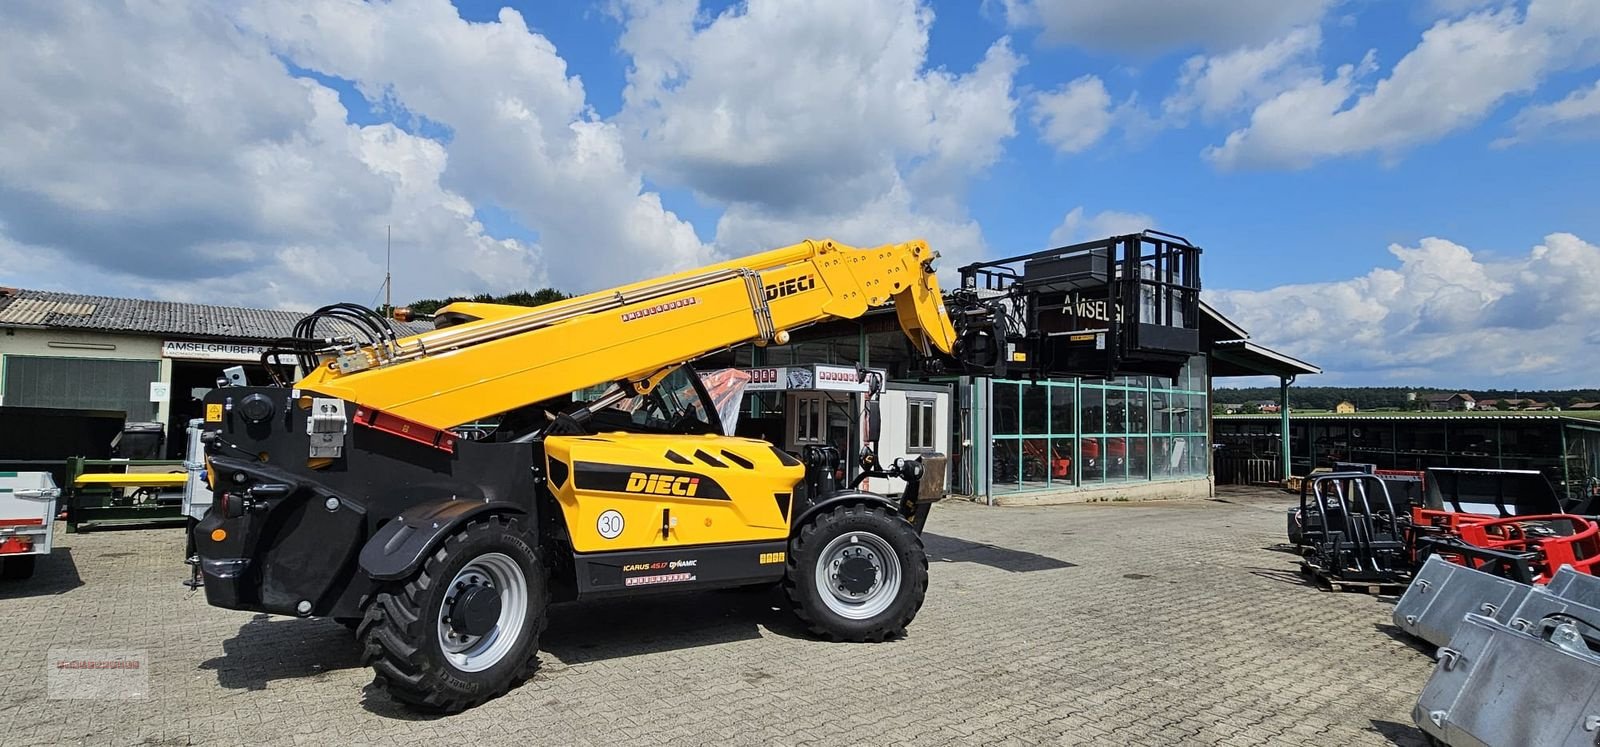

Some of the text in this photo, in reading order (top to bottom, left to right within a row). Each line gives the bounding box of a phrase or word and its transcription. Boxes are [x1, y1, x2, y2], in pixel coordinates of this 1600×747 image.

[765, 273, 815, 301] DIECI
[167, 342, 254, 354] AMSELGRUBER
[625, 472, 700, 497] DIECI
[601, 515, 621, 533] 30
[623, 563, 650, 572] ICARUS
[669, 559, 698, 570] DYNAMIC
